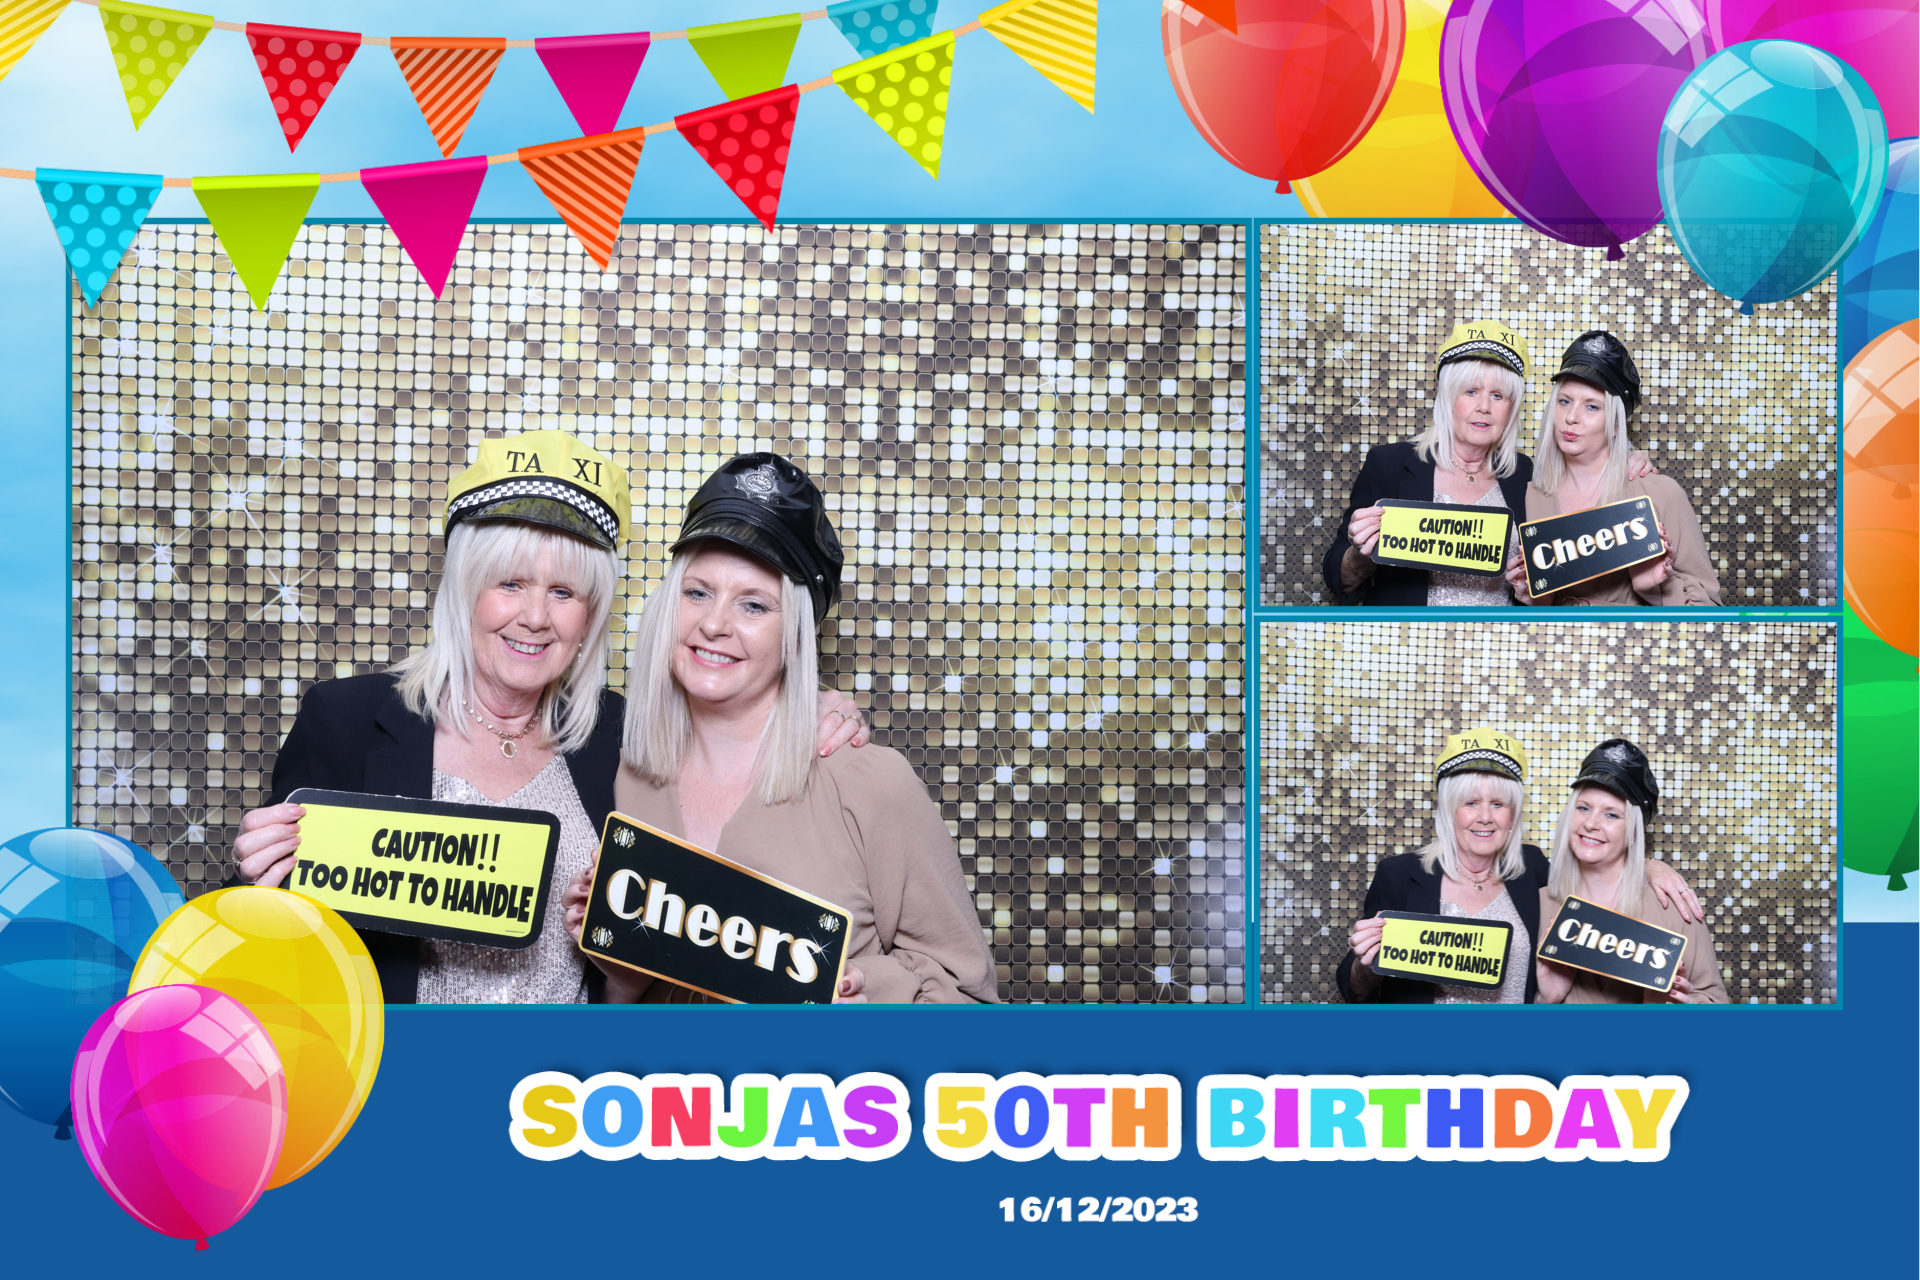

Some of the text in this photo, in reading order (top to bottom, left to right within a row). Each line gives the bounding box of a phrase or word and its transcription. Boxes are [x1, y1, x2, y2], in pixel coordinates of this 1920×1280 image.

[506, 450, 603, 488] TA XI
[1418, 517, 1484, 539] CAUTION!!
[1531, 516, 1649, 570] Cheers
[1382, 534, 1502, 565] TOO HOT TO HANDLE
[371, 828, 501, 873] CAUTION!!
[297, 859, 535, 923] TOO HOT TO HANDLE
[606, 868, 821, 984] Cheers
[1419, 929, 1484, 952] CAUTION!!
[1557, 918, 1670, 970] Cheers
[1382, 945, 1501, 978] TOO HOT TO HANDLE
